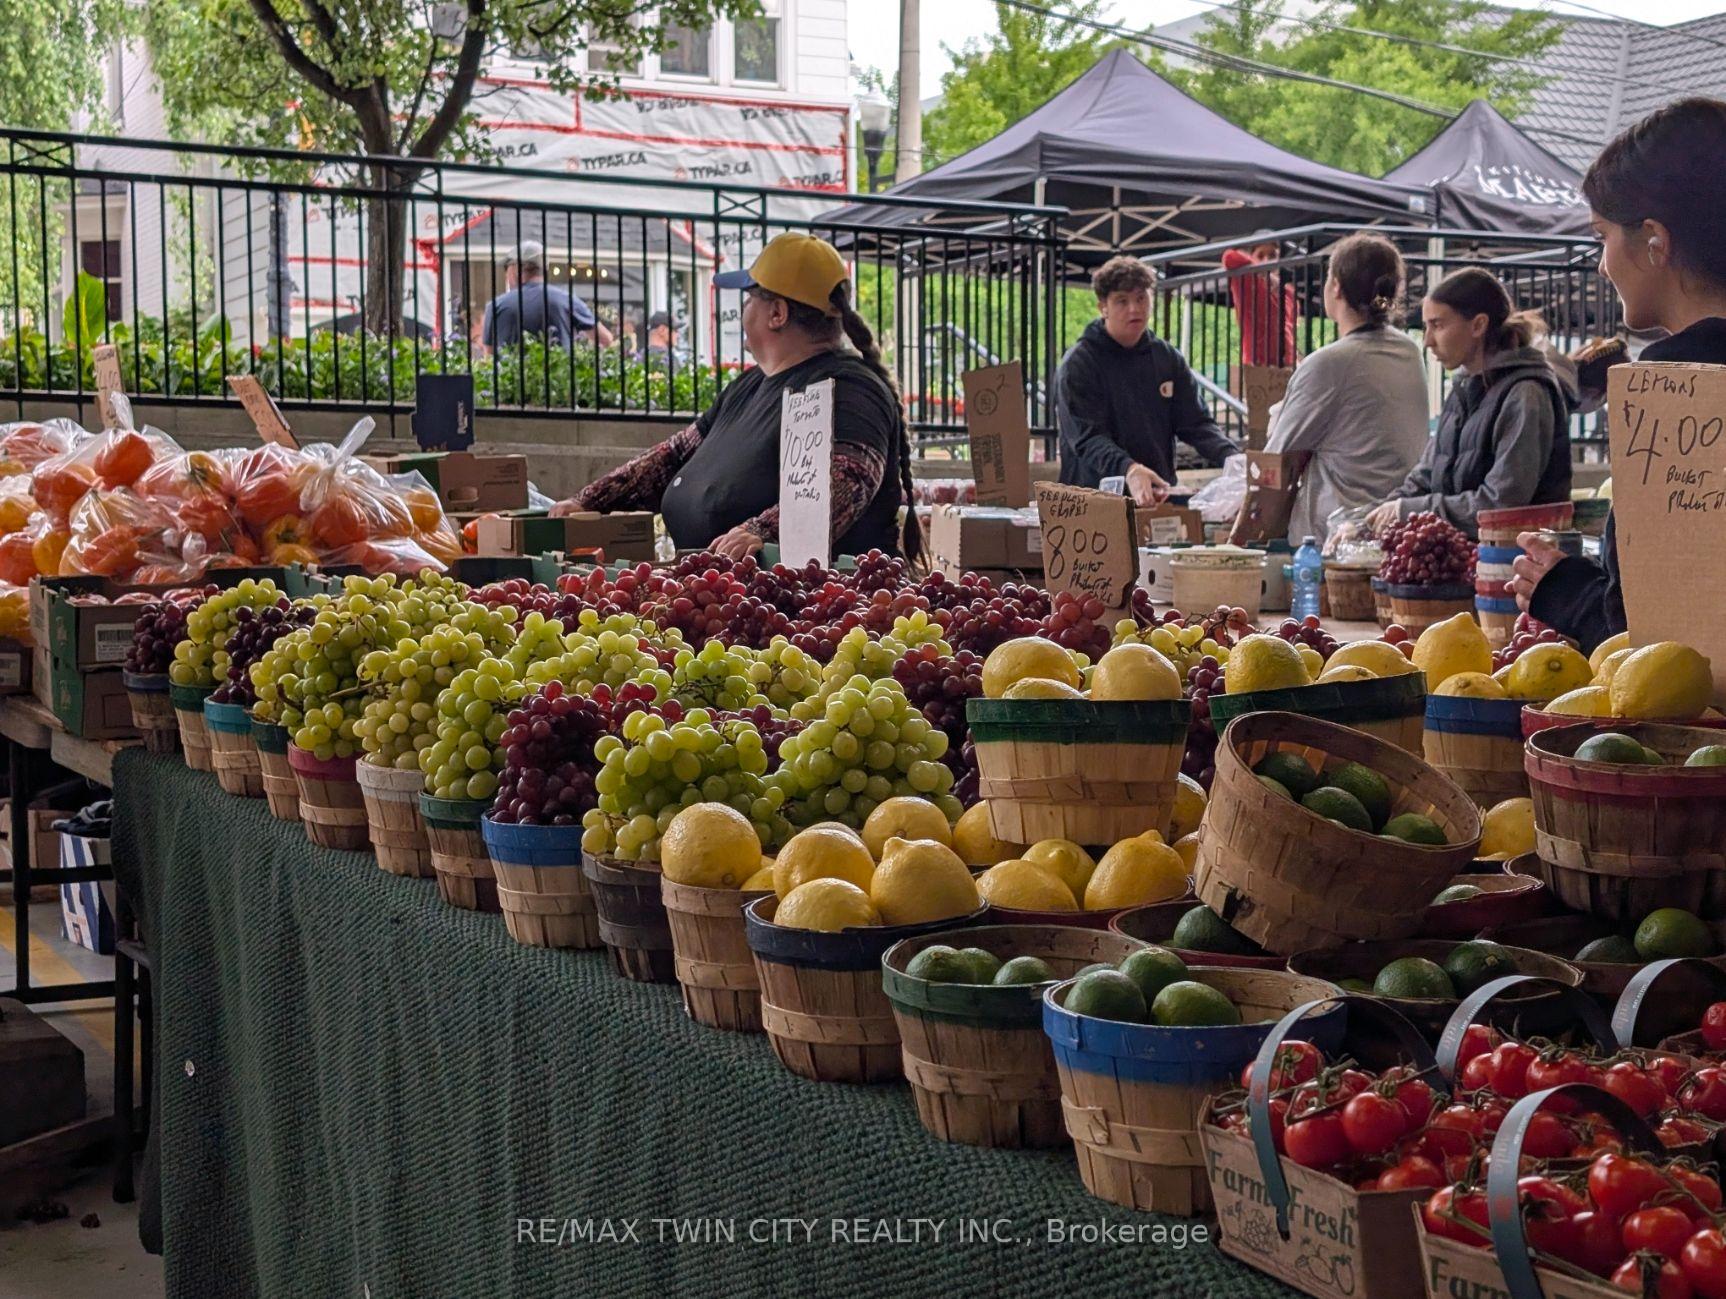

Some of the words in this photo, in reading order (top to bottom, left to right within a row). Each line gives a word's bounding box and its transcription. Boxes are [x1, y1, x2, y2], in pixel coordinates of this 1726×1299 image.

[582, 151, 648, 171] TYPAR.CA
[688, 161, 752, 180] TYPAR.CA
[1208, 1150, 1272, 1207] Farm
[1288, 1184, 1356, 1249] Fresh
